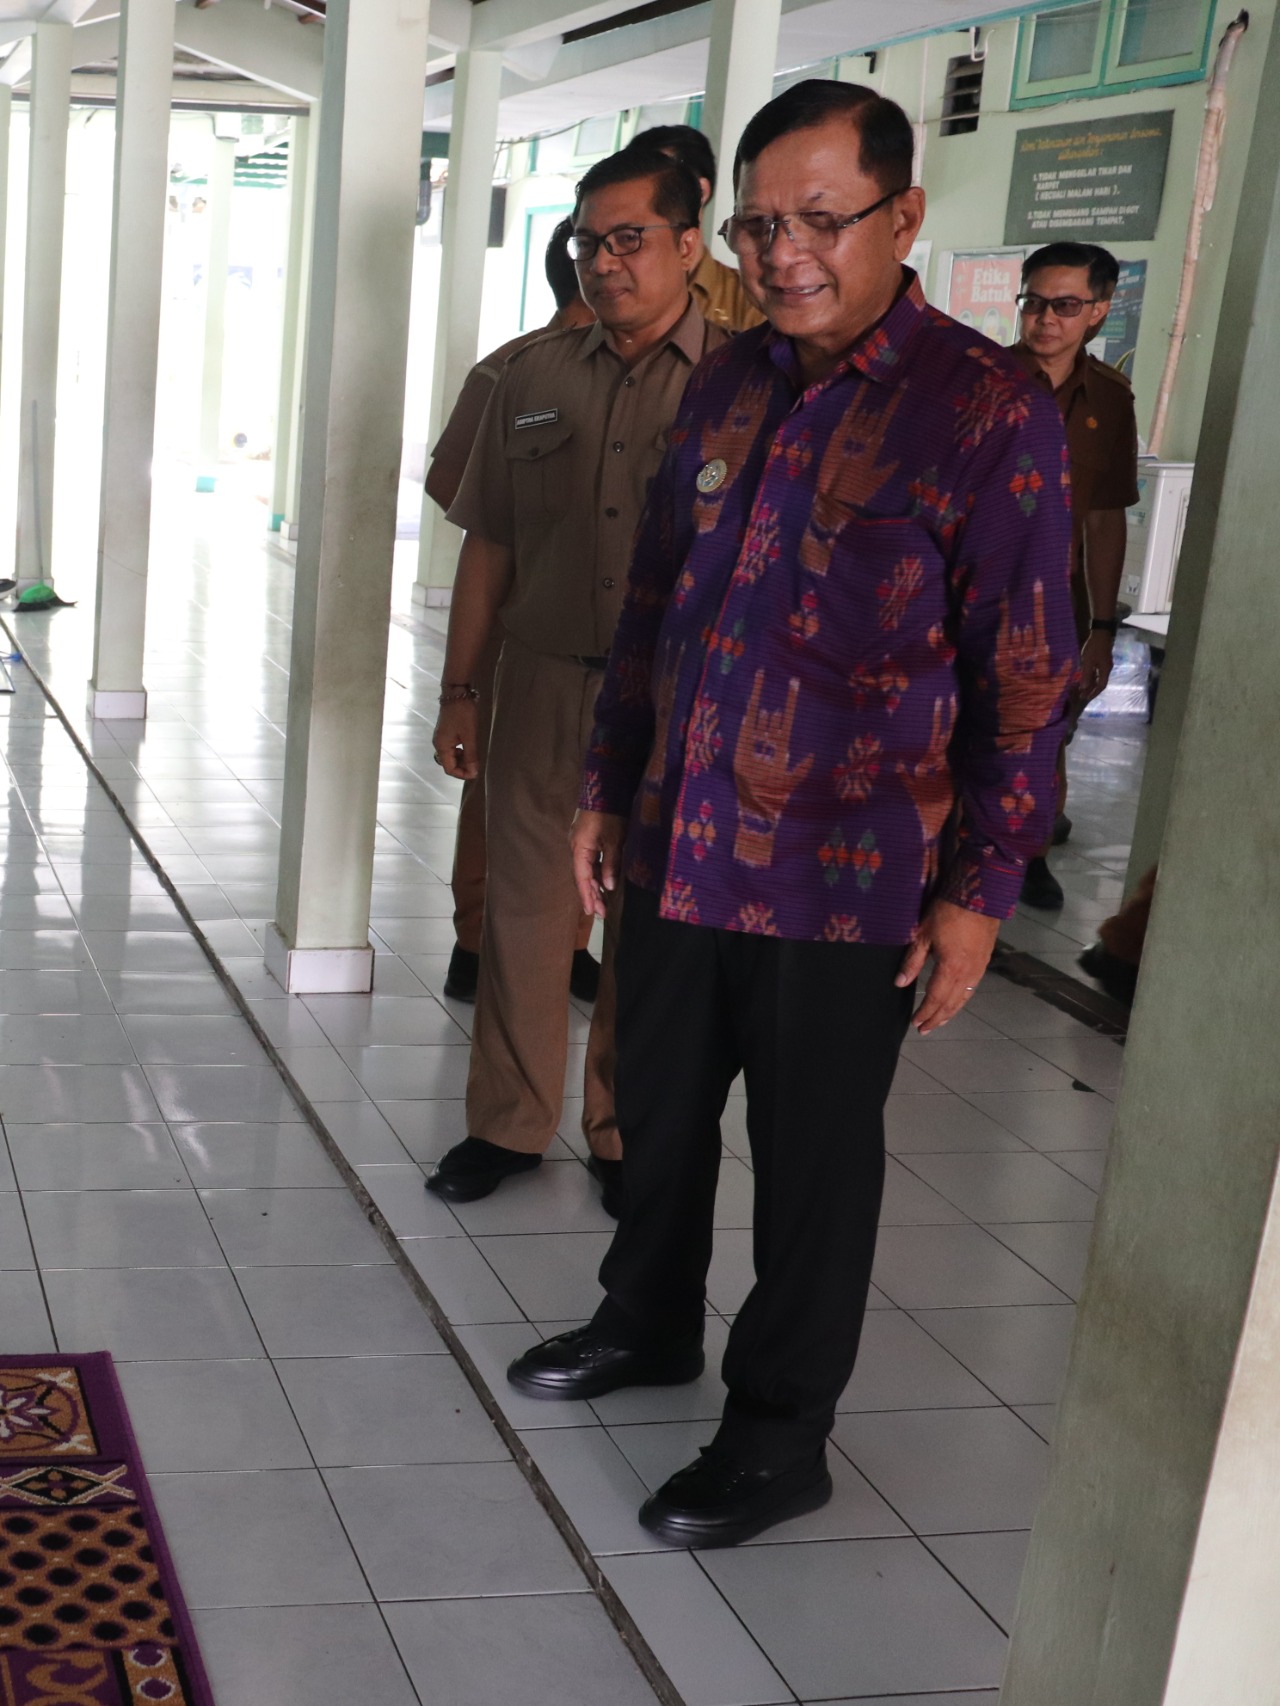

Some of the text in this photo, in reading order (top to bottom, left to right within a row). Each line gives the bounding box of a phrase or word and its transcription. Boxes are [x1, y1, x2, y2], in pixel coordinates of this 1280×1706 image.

[1066, 188, 1093, 198] MALAM
[1093, 186, 1111, 196] HARI
[973, 267, 1011, 285] Etika
[971, 284, 1013, 303] Batuk
